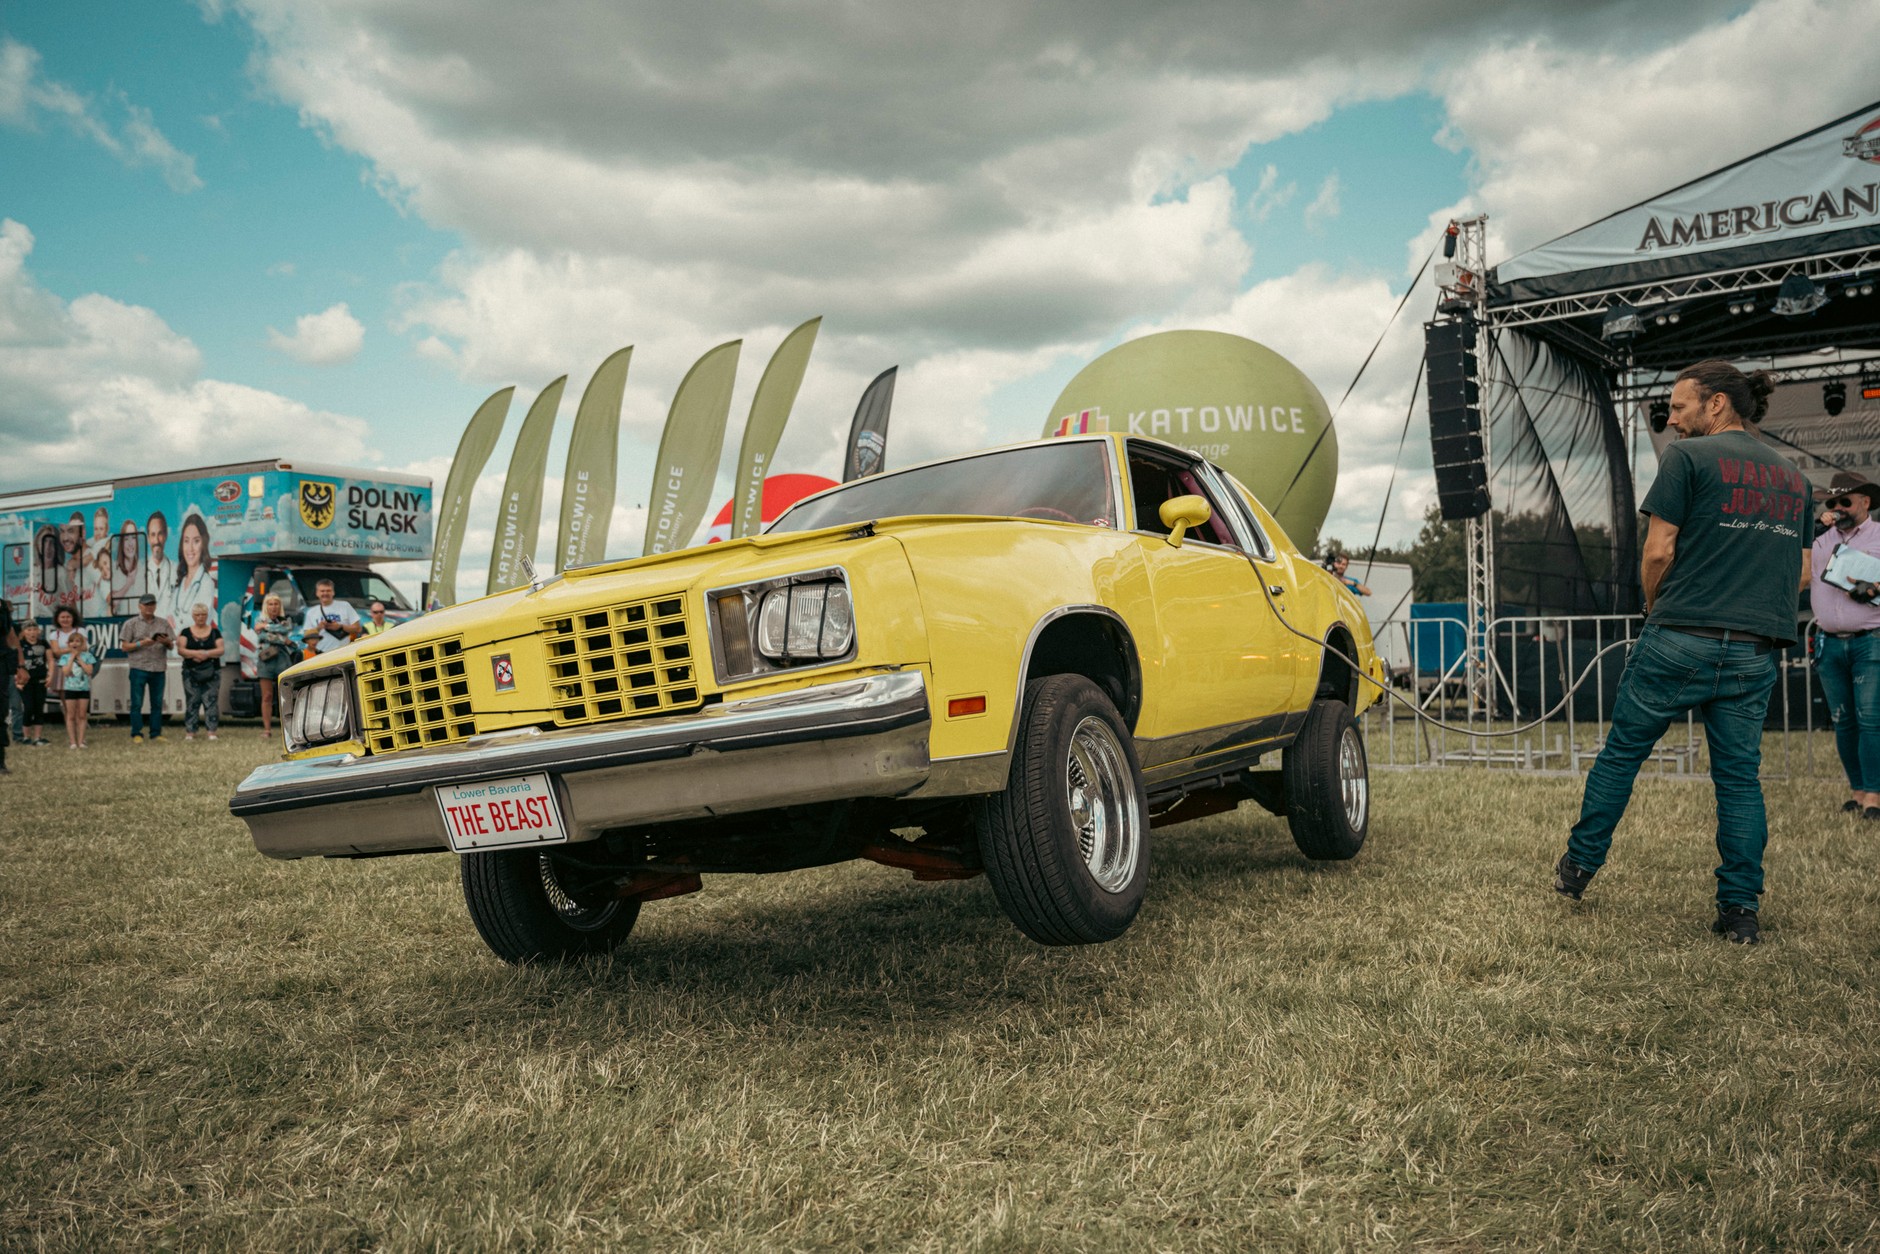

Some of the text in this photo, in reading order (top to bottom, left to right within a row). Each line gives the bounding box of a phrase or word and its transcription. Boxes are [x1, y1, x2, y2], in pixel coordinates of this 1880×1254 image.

[1636, 182, 1880, 252] AMERICAN
[1128, 405, 1305, 436] KATOWICE
[1718, 457, 1806, 498] WANNA
[348, 486, 422, 512] DOLNY
[652, 465, 684, 554] ATOWICE
[1721, 487, 1804, 521] JUMP?
[348, 505, 417, 535] ŚLĄSK
[298, 536, 339, 548] MOBILNE
[341, 539, 383, 550] CENTRUM
[496, 491, 520, 585] KATOWICE
[453, 783, 531, 800] Lower Bavaria
[447, 796, 552, 836] THE BEAST
